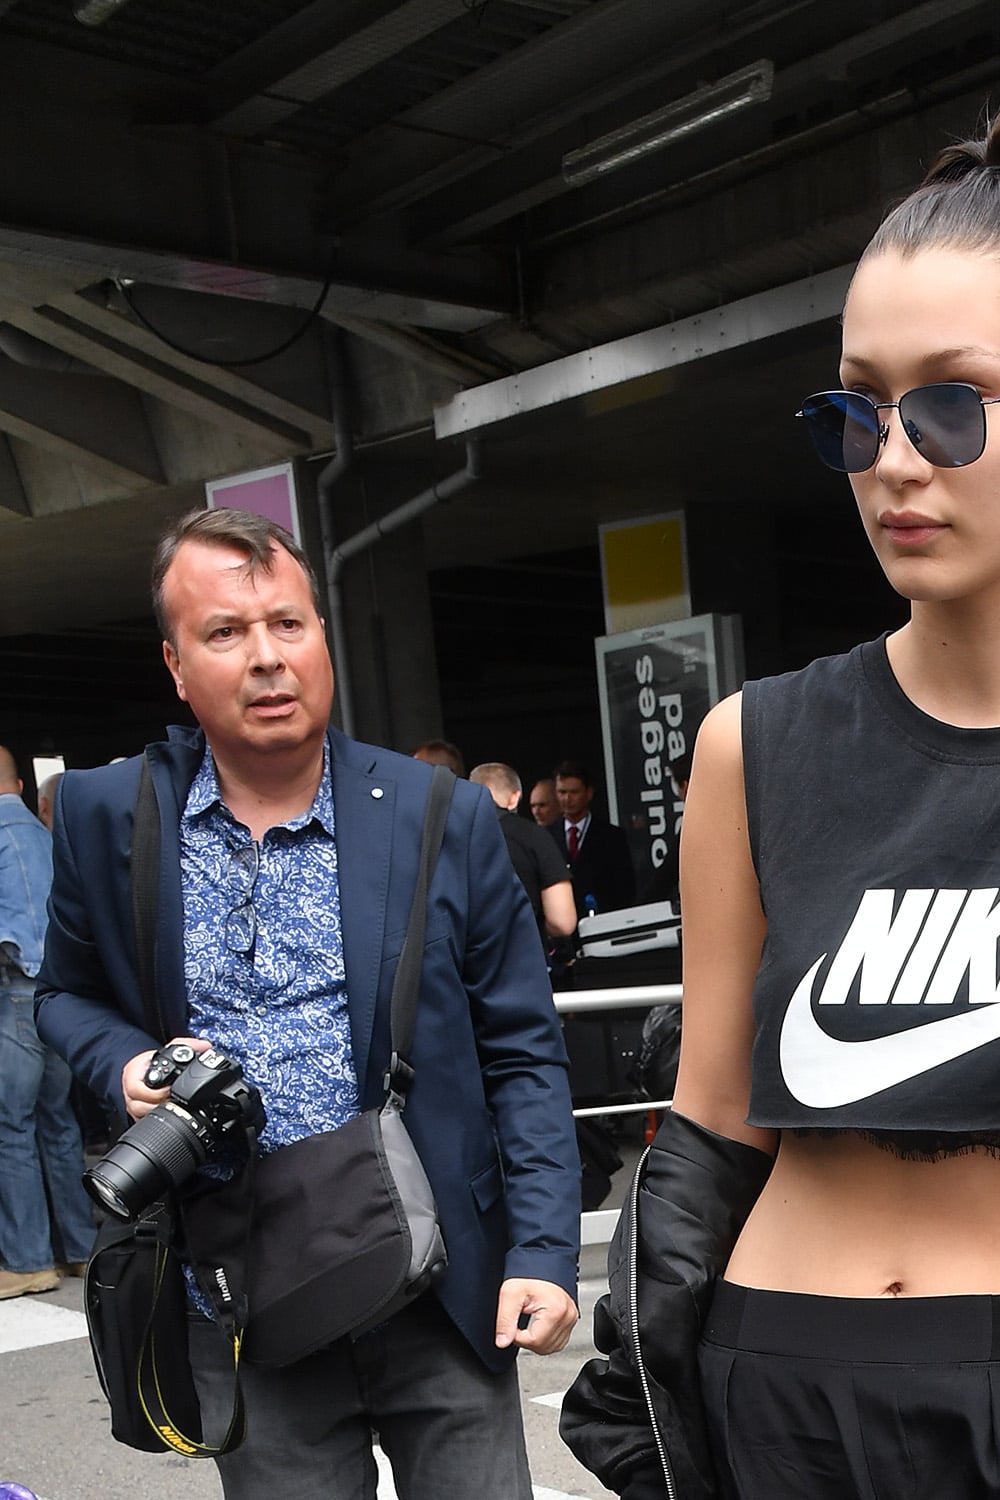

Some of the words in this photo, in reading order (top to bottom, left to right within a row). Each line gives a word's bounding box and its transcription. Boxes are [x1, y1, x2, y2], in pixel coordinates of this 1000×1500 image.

[635, 655, 668, 869] oulages
[215, 1267, 232, 1302] Nikon
[158, 1425, 197, 1453] Nikon
